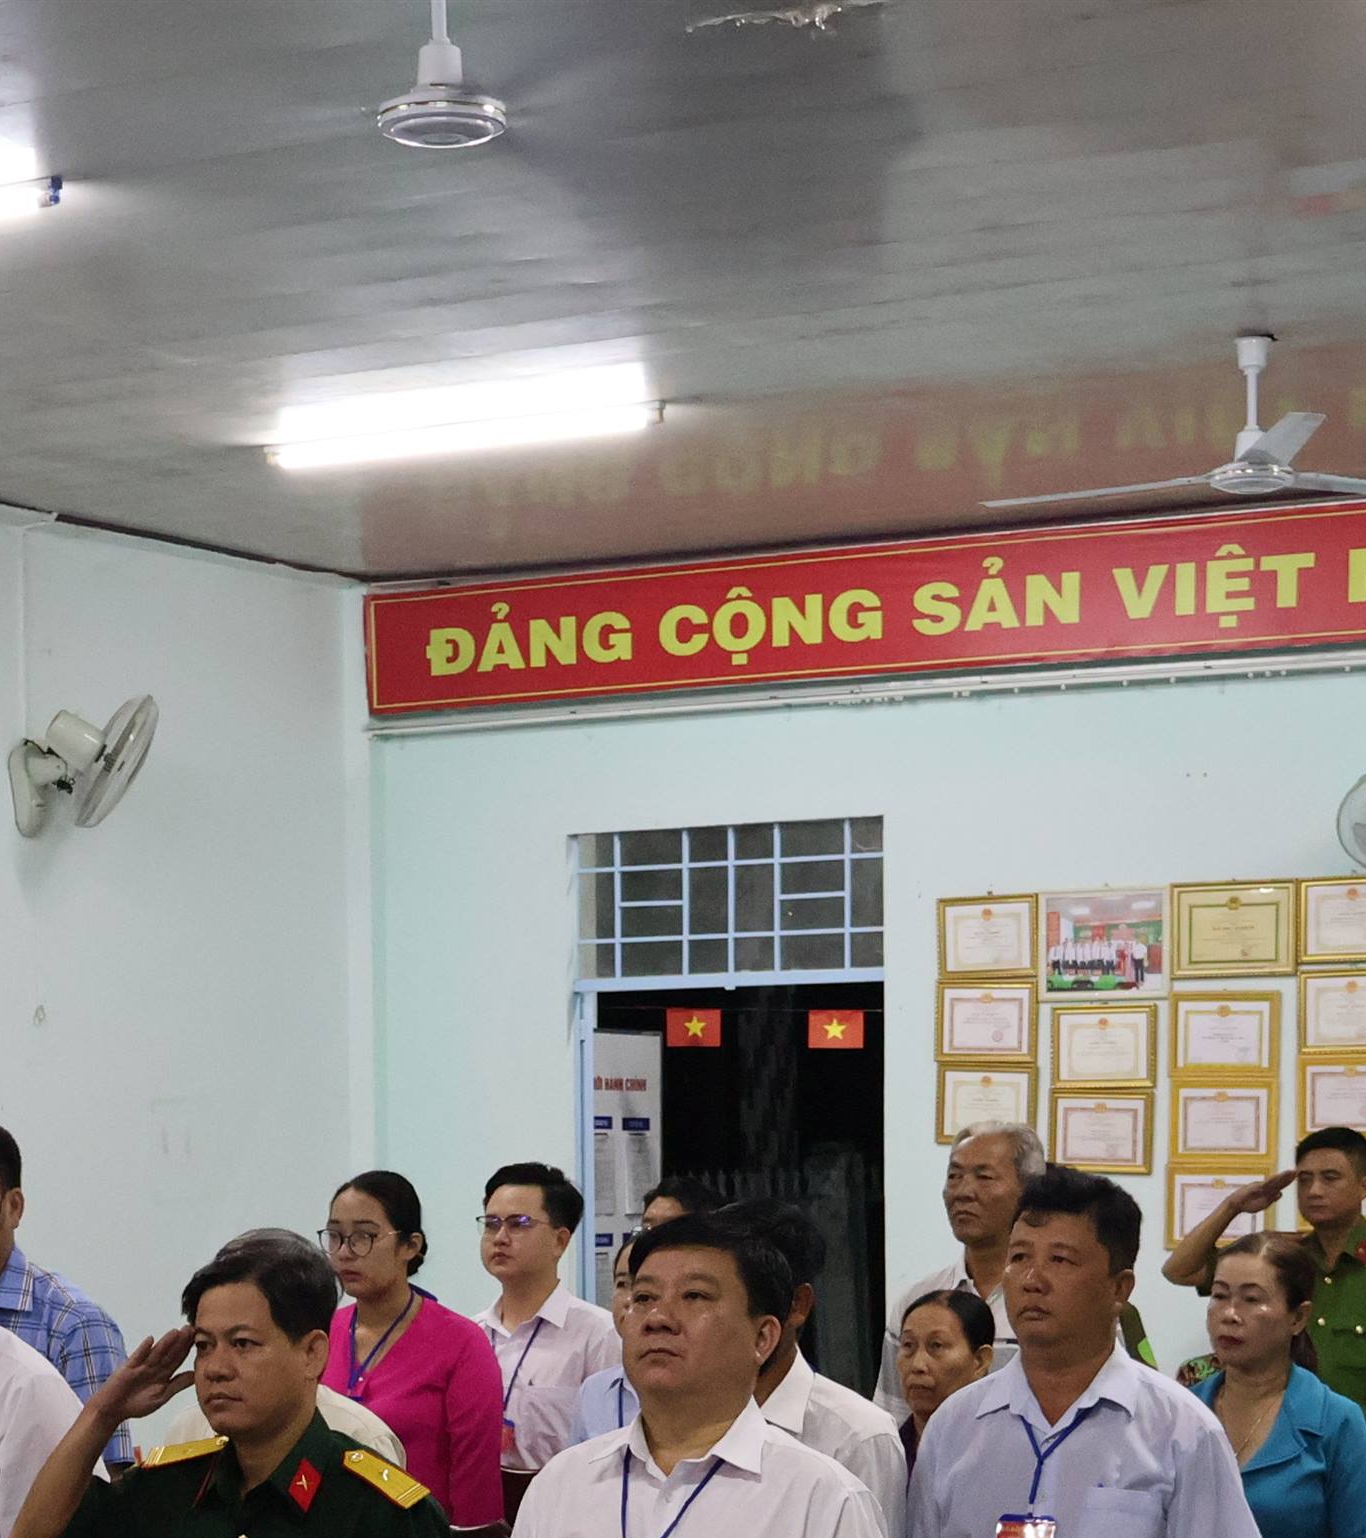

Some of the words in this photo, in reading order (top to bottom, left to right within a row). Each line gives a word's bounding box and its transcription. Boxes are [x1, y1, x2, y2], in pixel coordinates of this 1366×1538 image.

[426, 604, 633, 676] ĐẢNG
[659, 588, 883, 664] CỘNG
[913, 557, 1081, 636] SẢN
[1113, 544, 1315, 628] VIỆT
